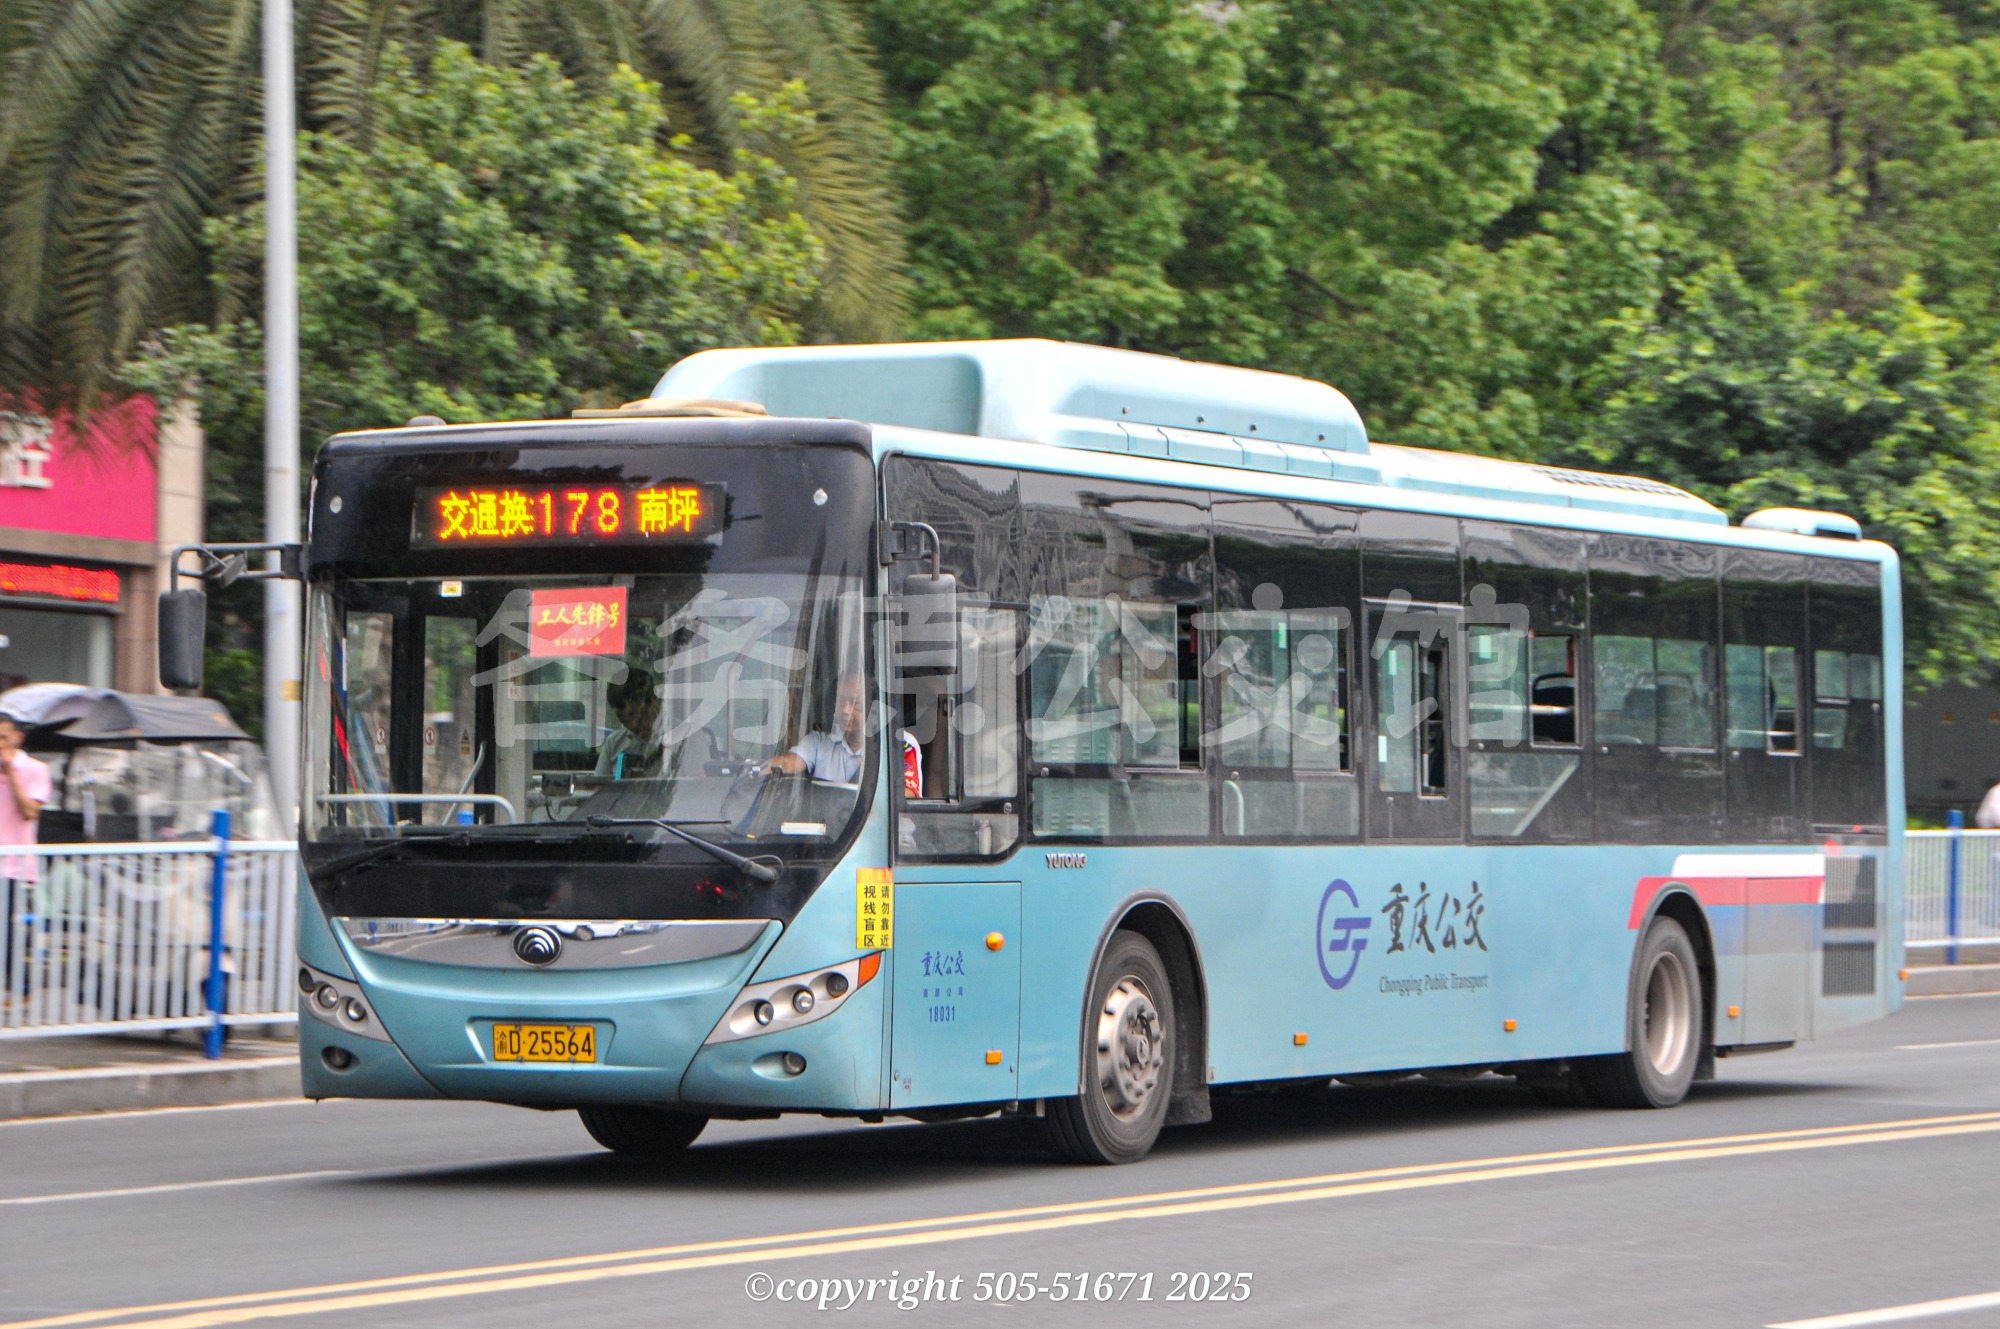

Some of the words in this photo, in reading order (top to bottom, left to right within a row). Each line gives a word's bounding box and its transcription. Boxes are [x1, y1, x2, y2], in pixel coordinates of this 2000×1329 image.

[440, 491, 534, 538] 交通换
[539, 491, 620, 534] 178
[636, 487, 700, 532] 南坪
[537, 602, 620, 628] 工人先锋号
[1045, 853, 1088, 869] YUTONG
[863, 885, 876, 947] 视线盲区
[880, 885, 890, 947] 请勿靠近
[1381, 880, 1489, 954] 重庆公交
[921, 950, 965, 977] 重庆公交
[1424, 973, 1448, 990] Public
[1450, 972, 1488, 993] Transport
[929, 1006, 955, 1022] 18031
